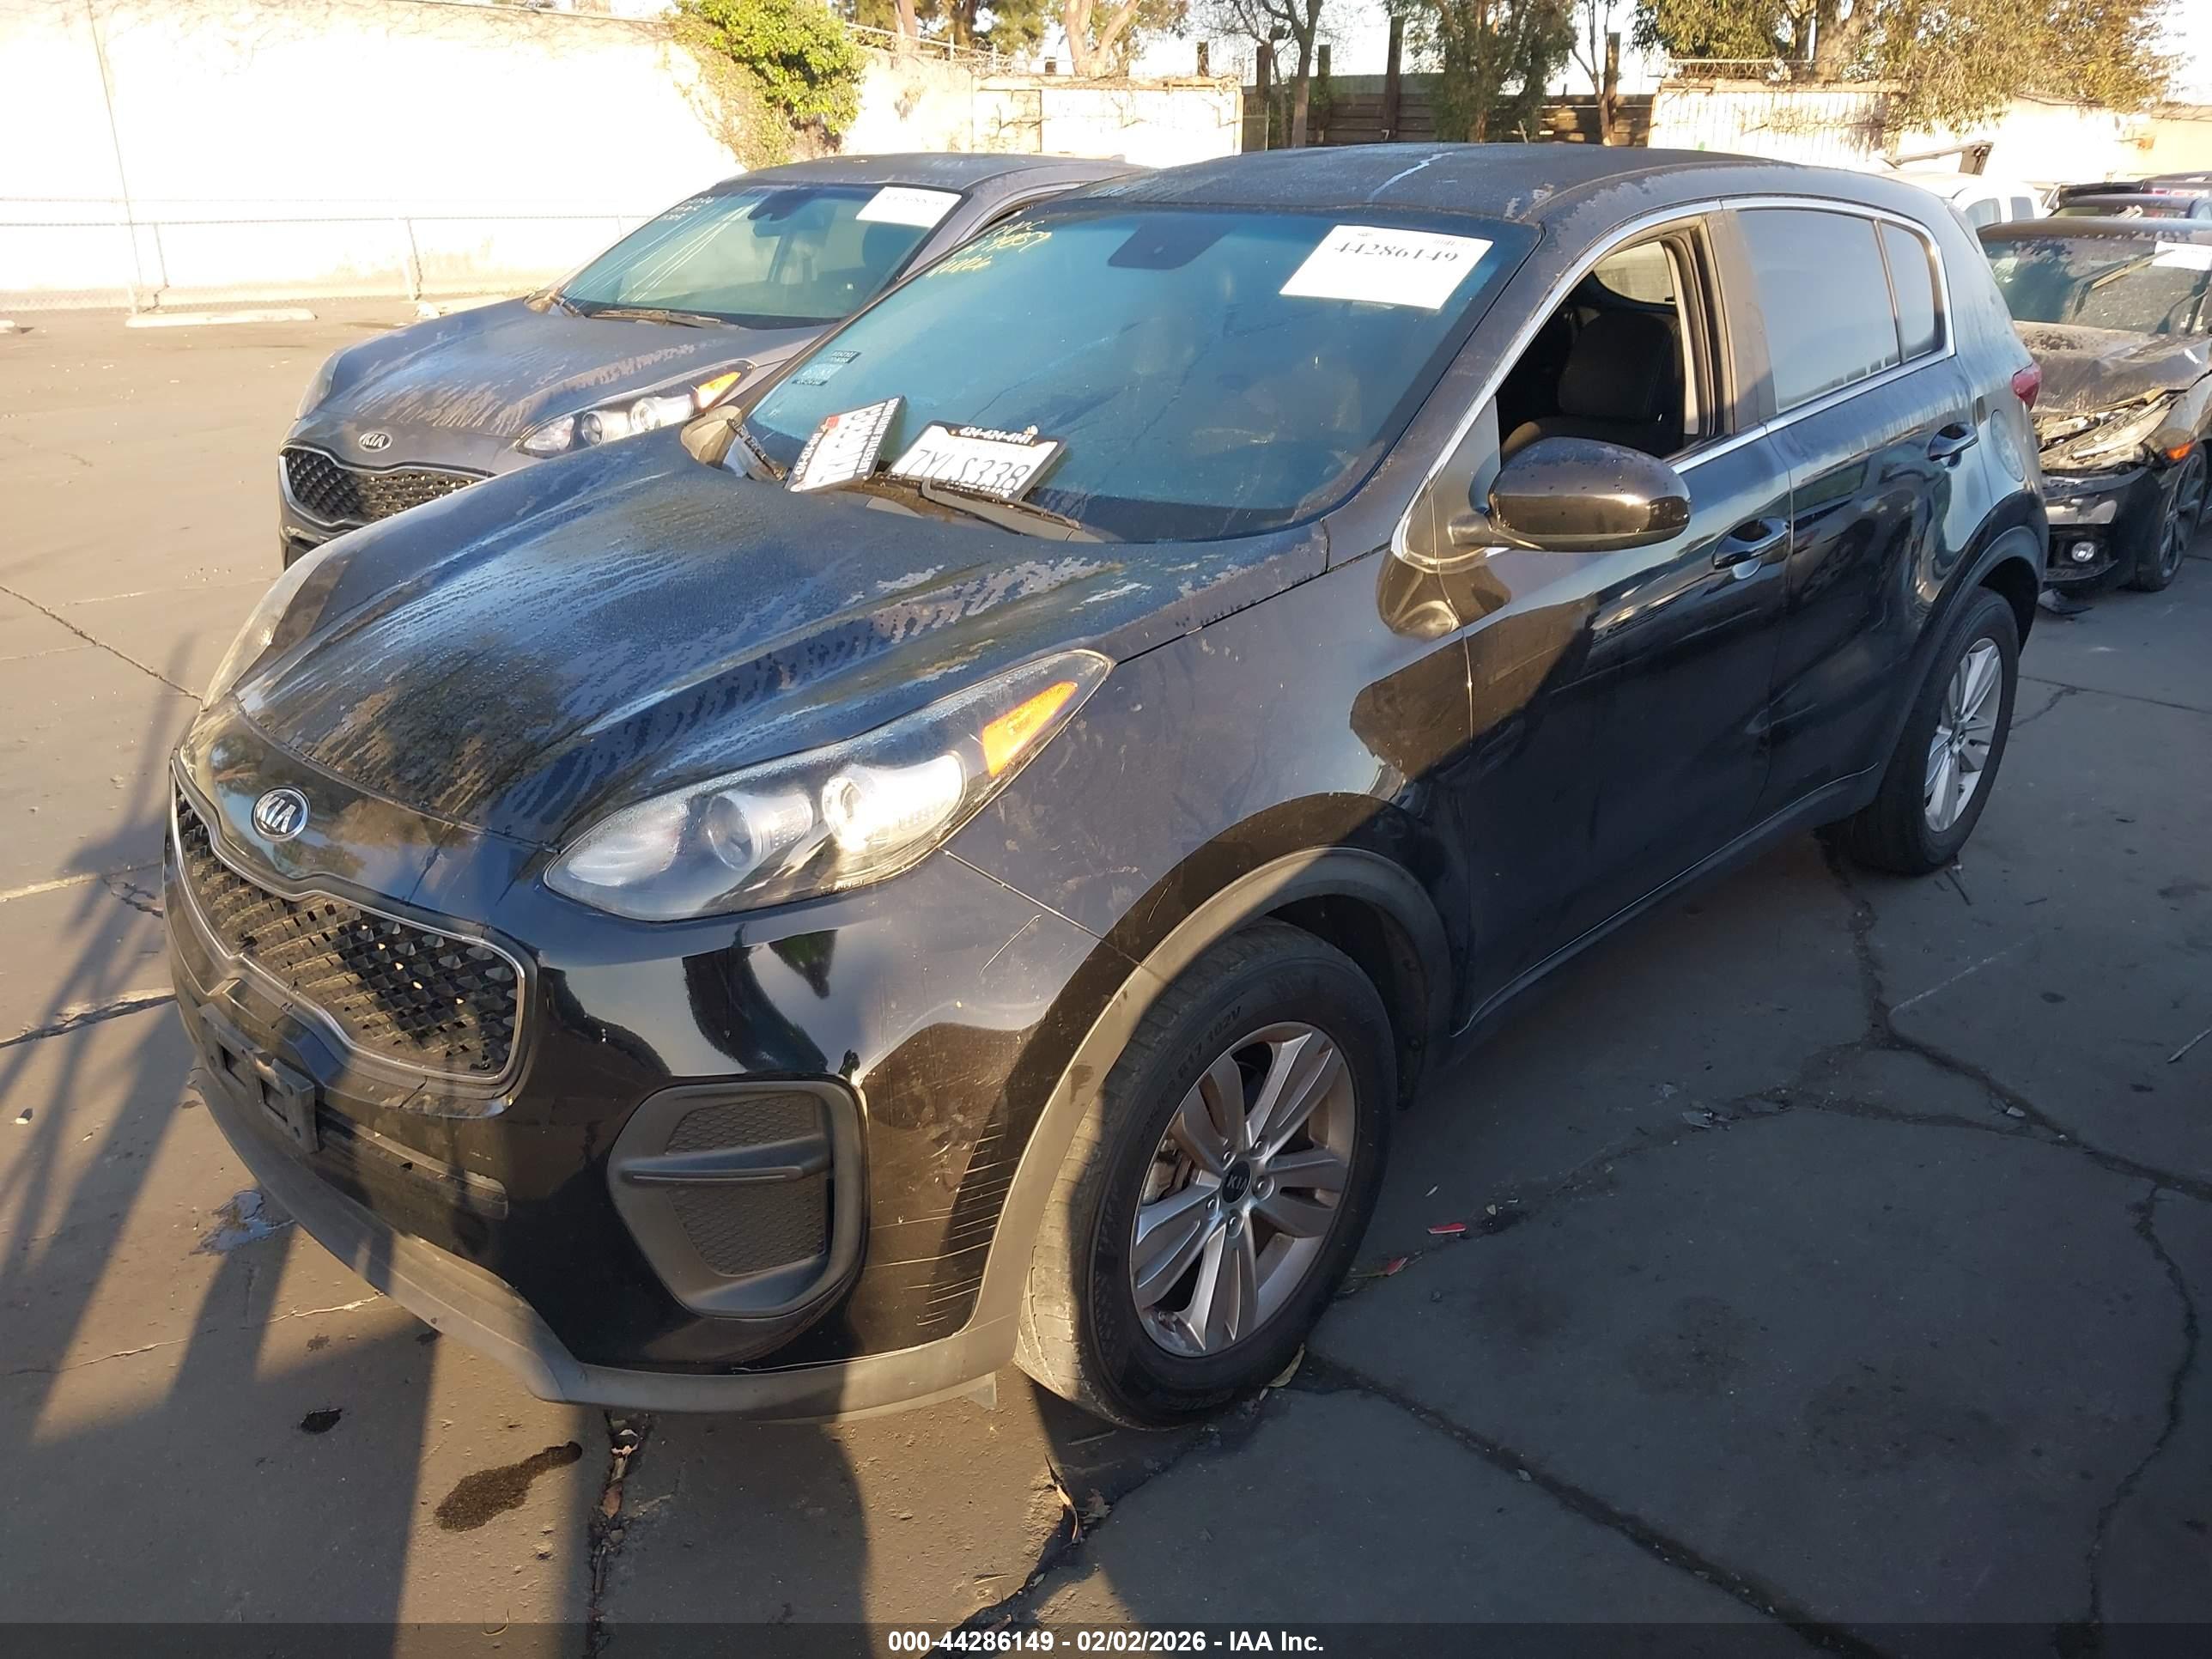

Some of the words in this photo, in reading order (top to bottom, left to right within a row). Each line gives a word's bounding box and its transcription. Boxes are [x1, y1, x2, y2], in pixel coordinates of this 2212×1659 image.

[1333, 240, 1459, 262] 44286149
[362, 433, 386, 448] KIA
[856, 434, 882, 474] LIFESTYLE
[256, 793, 297, 834] KIA
[1226, 1175, 1248, 1190] KIA
